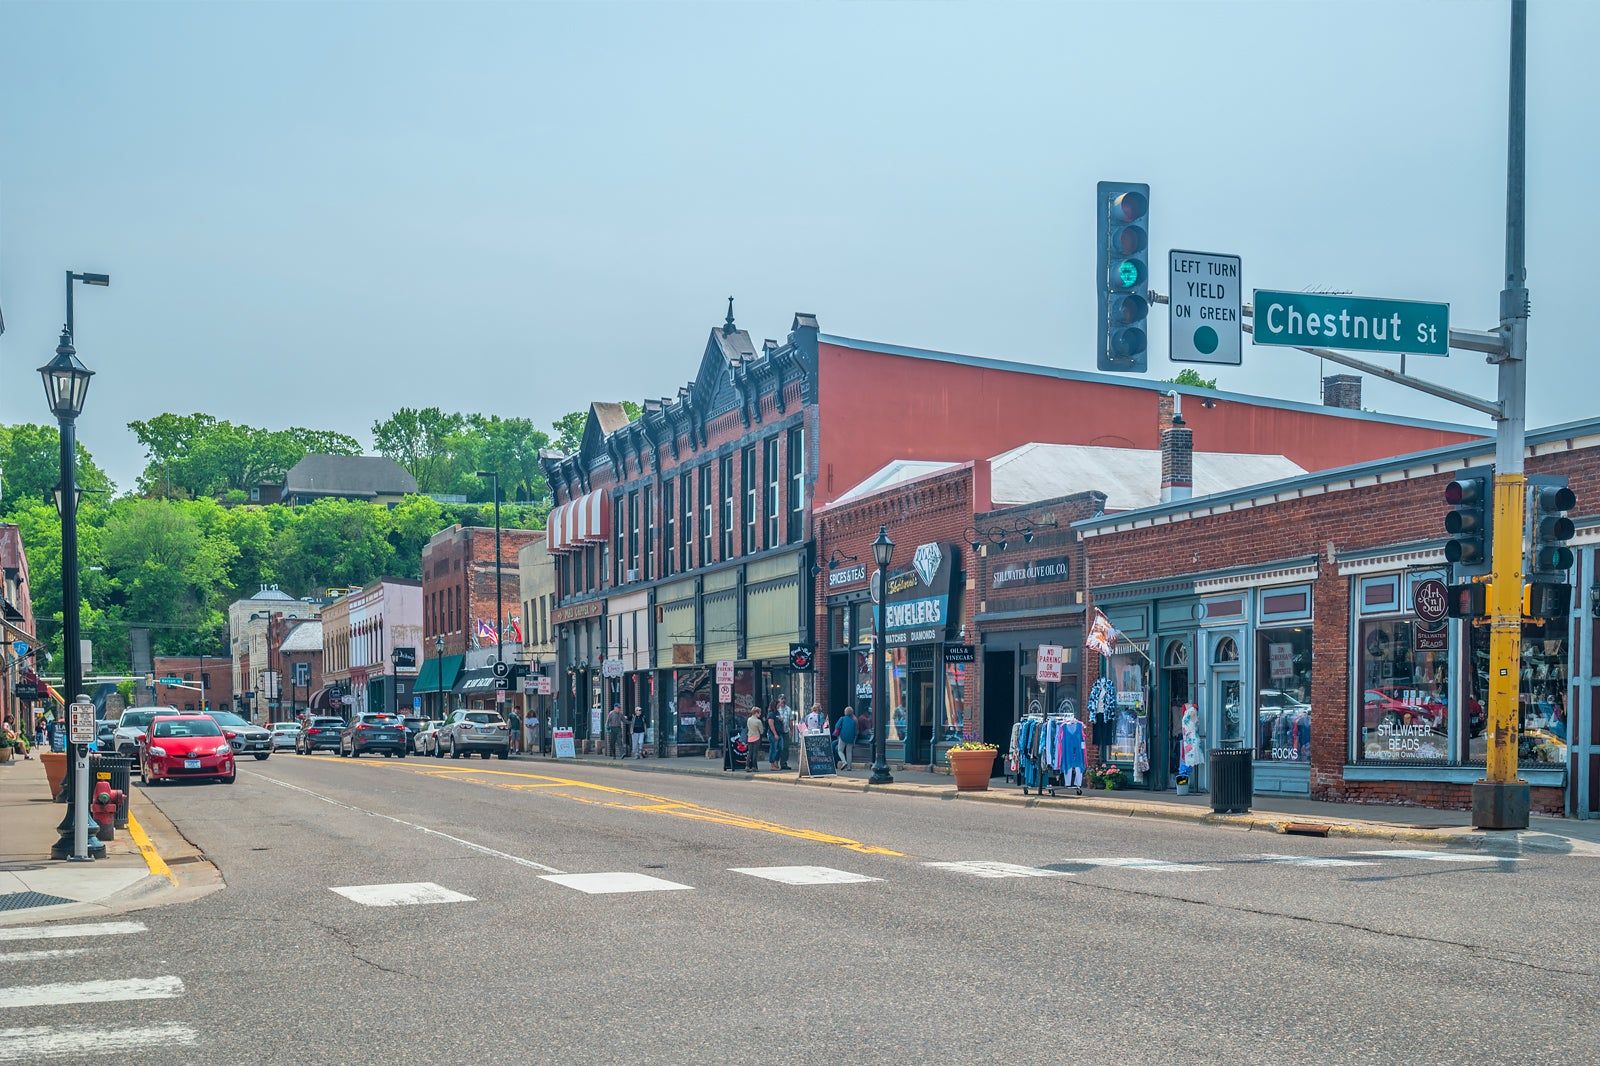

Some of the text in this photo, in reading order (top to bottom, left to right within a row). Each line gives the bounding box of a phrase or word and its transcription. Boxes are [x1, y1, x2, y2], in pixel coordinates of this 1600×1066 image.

[1174, 259, 1237, 277] LEFT TURN
[1187, 281, 1225, 299] YIELD
[1175, 304, 1236, 321] ON GREEN
[1267, 303, 1437, 343] Chestnut St
[829, 570, 847, 586] SPICES
[850, 567, 865, 580] TEAS
[993, 563, 1067, 583] STILLWATER OLIVE OIL CO.
[1419, 584, 1439, 603] Art
[885, 599, 941, 628] EWELERS
[1422, 597, 1442, 613] Soul
[911, 630, 936, 641] DIAMONDS
[498, 665, 505, 674] P
[1388, 738, 1420, 751] BEADS
[1272, 748, 1299, 760] ROCKS
[1385, 751, 1400, 759] YOUR
